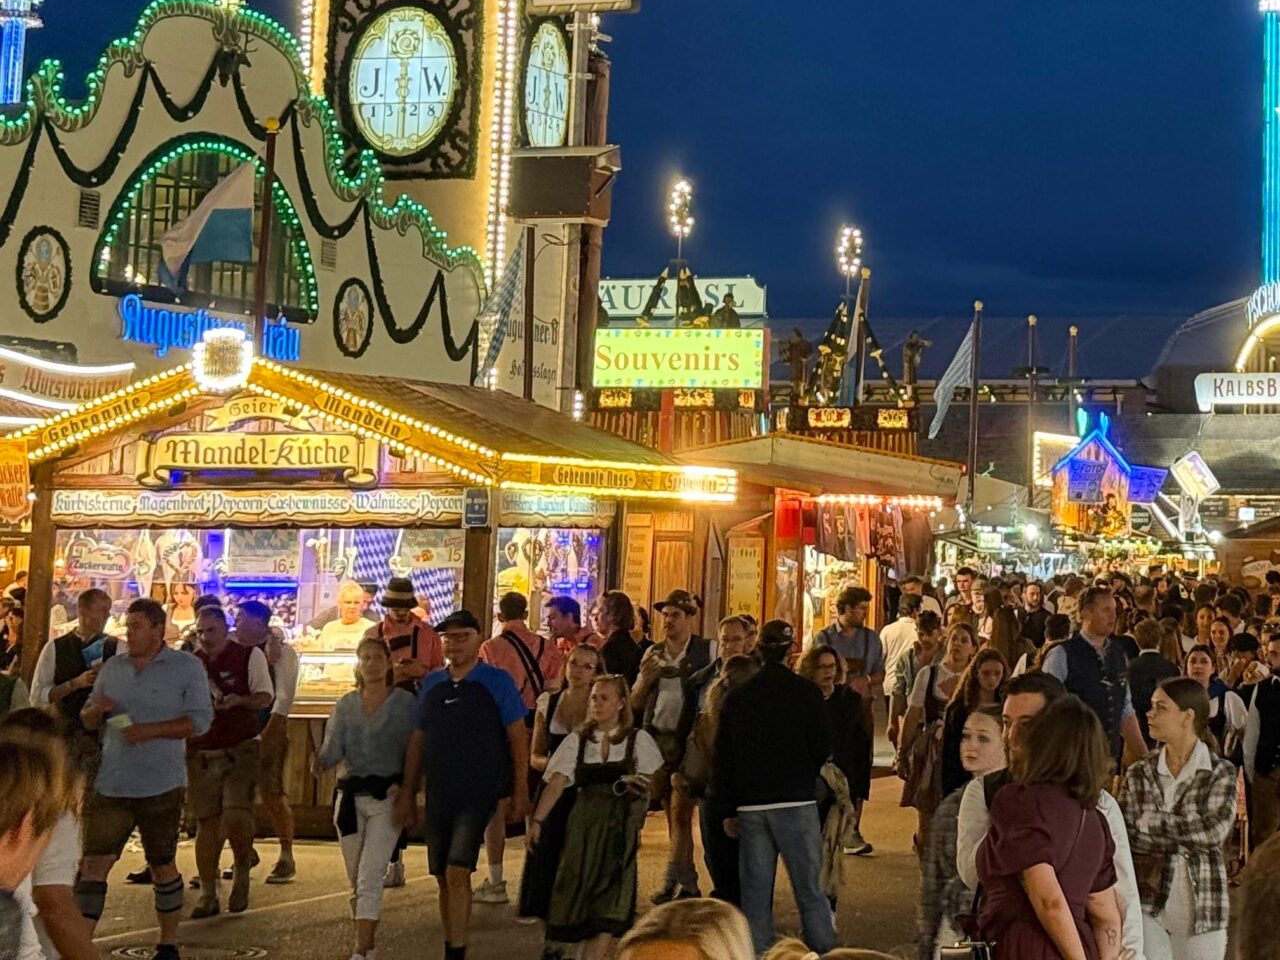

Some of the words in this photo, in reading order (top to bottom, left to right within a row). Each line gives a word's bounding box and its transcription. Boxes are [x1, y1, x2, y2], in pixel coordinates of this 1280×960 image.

[596, 344, 740, 372] Souvenirs
[48, 395, 142, 441] Gebrannte
[323, 393, 402, 439] Mandeln
[165, 438, 350, 465] Mandel-Küche
[557, 466, 604, 485] Gebrannte
[139, 492, 207, 514] Magenbrot
[211, 492, 263, 515] Popcorn
[267, 493, 348, 513] Cashewnüsse
[356, 493, 418, 511] Walnüsse
